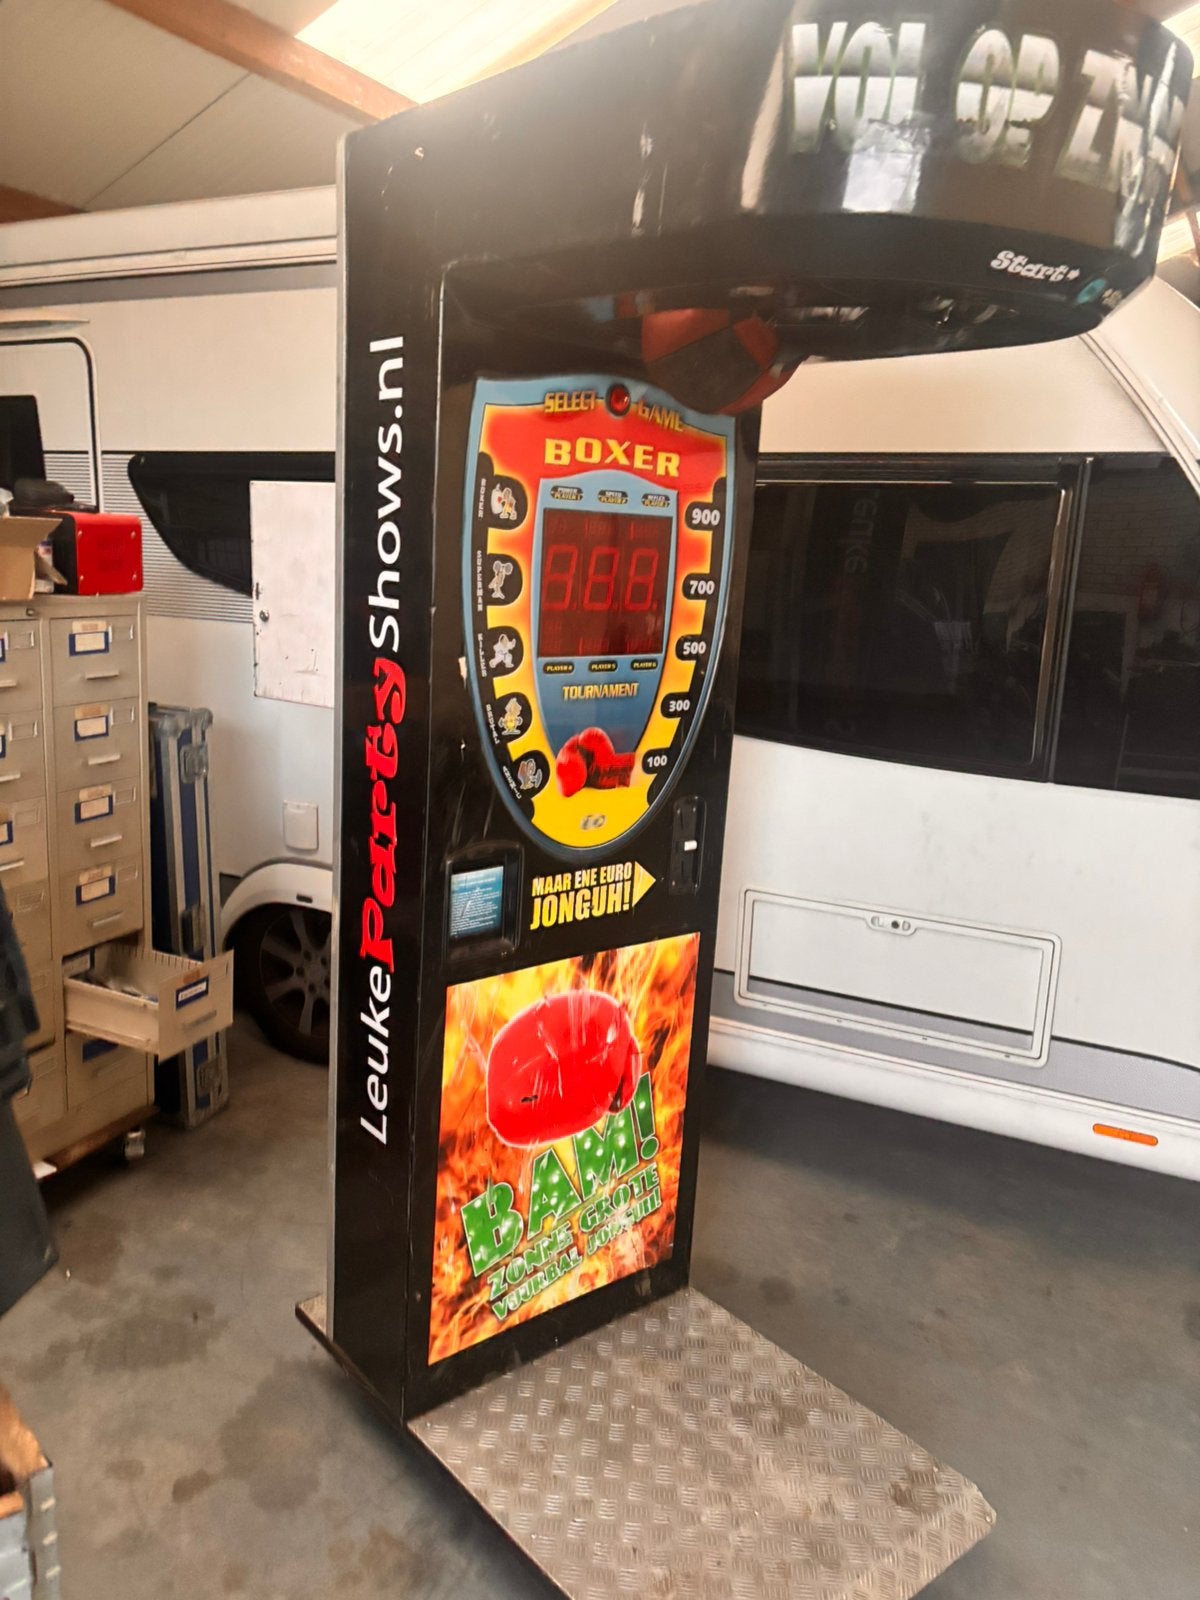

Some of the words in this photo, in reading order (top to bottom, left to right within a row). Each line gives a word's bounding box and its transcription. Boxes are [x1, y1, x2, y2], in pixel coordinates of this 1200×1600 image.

[990, 250, 1069, 282] Start
[544, 389, 597, 413] SELECT
[637, 397, 684, 432] GAME
[544, 437, 680, 477] BOXER
[691, 508, 721, 526] 900
[689, 580, 715, 595] 700
[682, 641, 706, 656] 500
[546, 664, 568, 672] PLAYER
[591, 663, 611, 671] PLAYER
[562, 682, 639, 701] TOURNAMENT
[668, 700, 690, 712] 300
[360, 335, 406, 1145] LeukePartyShows.nl
[646, 755, 668, 767] 100
[531, 873, 571, 897] MAAR
[574, 869, 598, 890] ENE
[599, 862, 633, 884] EURO
[530, 879, 633, 930] JONGUH!
[460, 1071, 660, 1277] BAM!
[579, 1162, 660, 1232] GROTE
